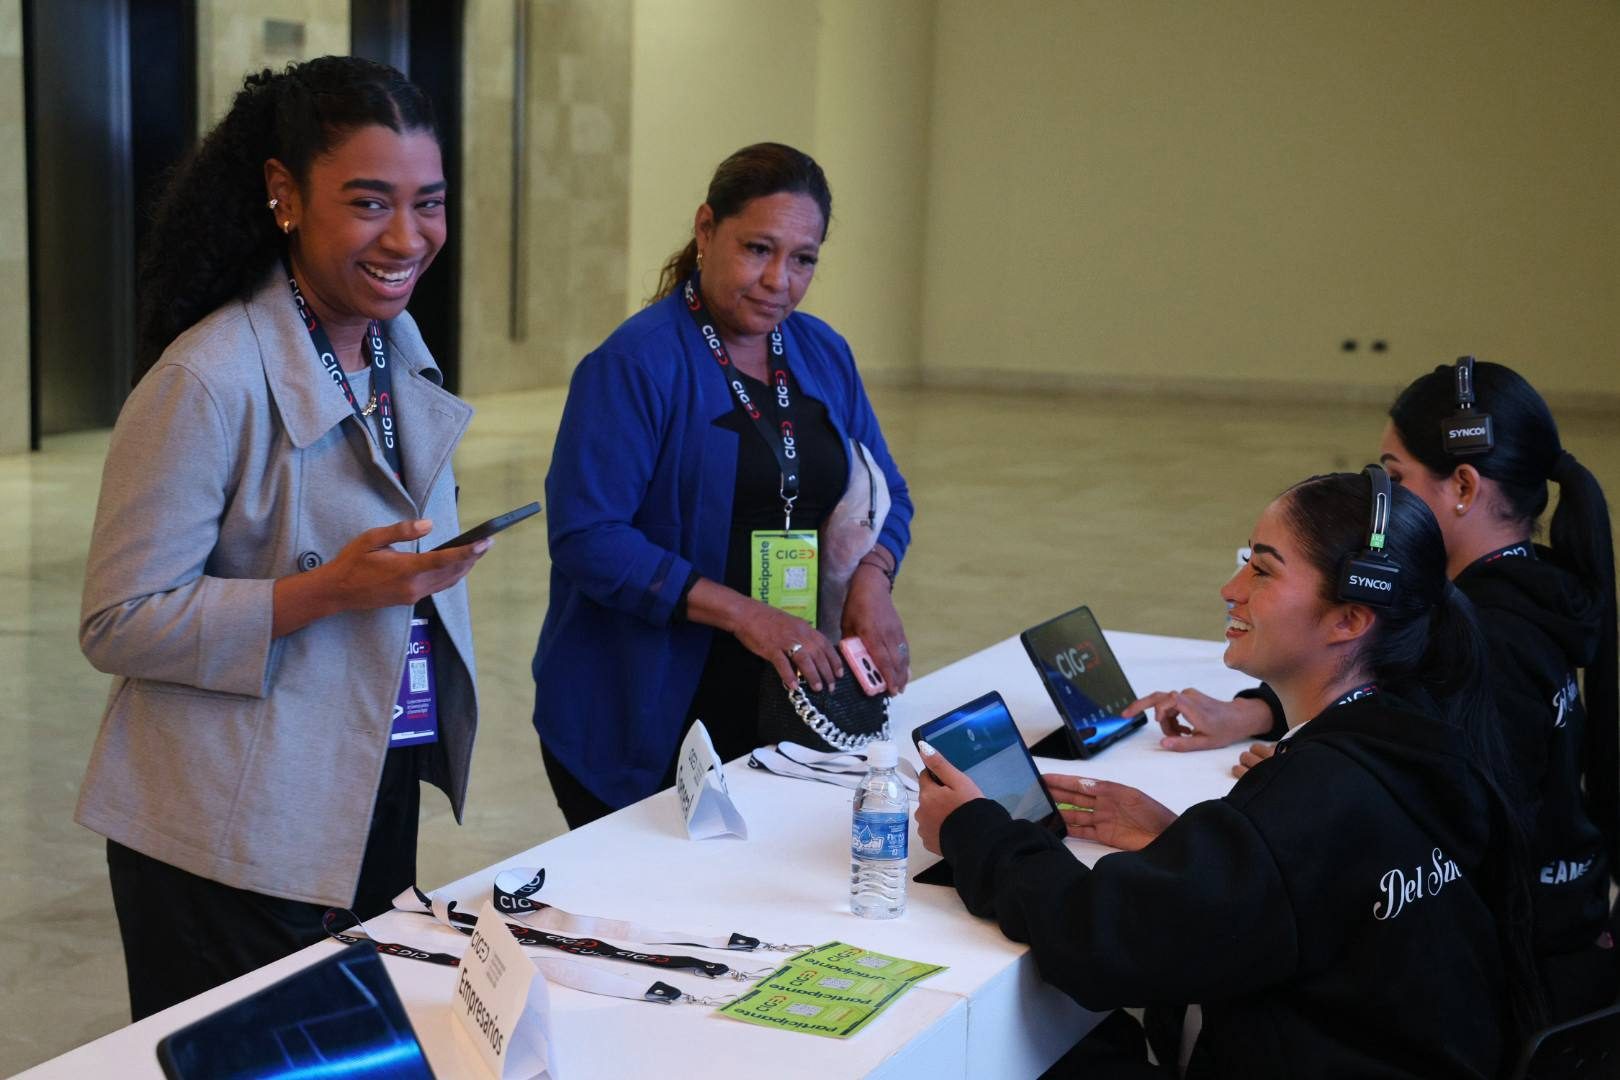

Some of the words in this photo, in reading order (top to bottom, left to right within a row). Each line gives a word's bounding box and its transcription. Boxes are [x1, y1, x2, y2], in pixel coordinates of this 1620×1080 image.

[1349, 575, 1387, 590] SYNCO
[1373, 866, 1423, 920] Del
[458, 967, 503, 1056] Empresarios
